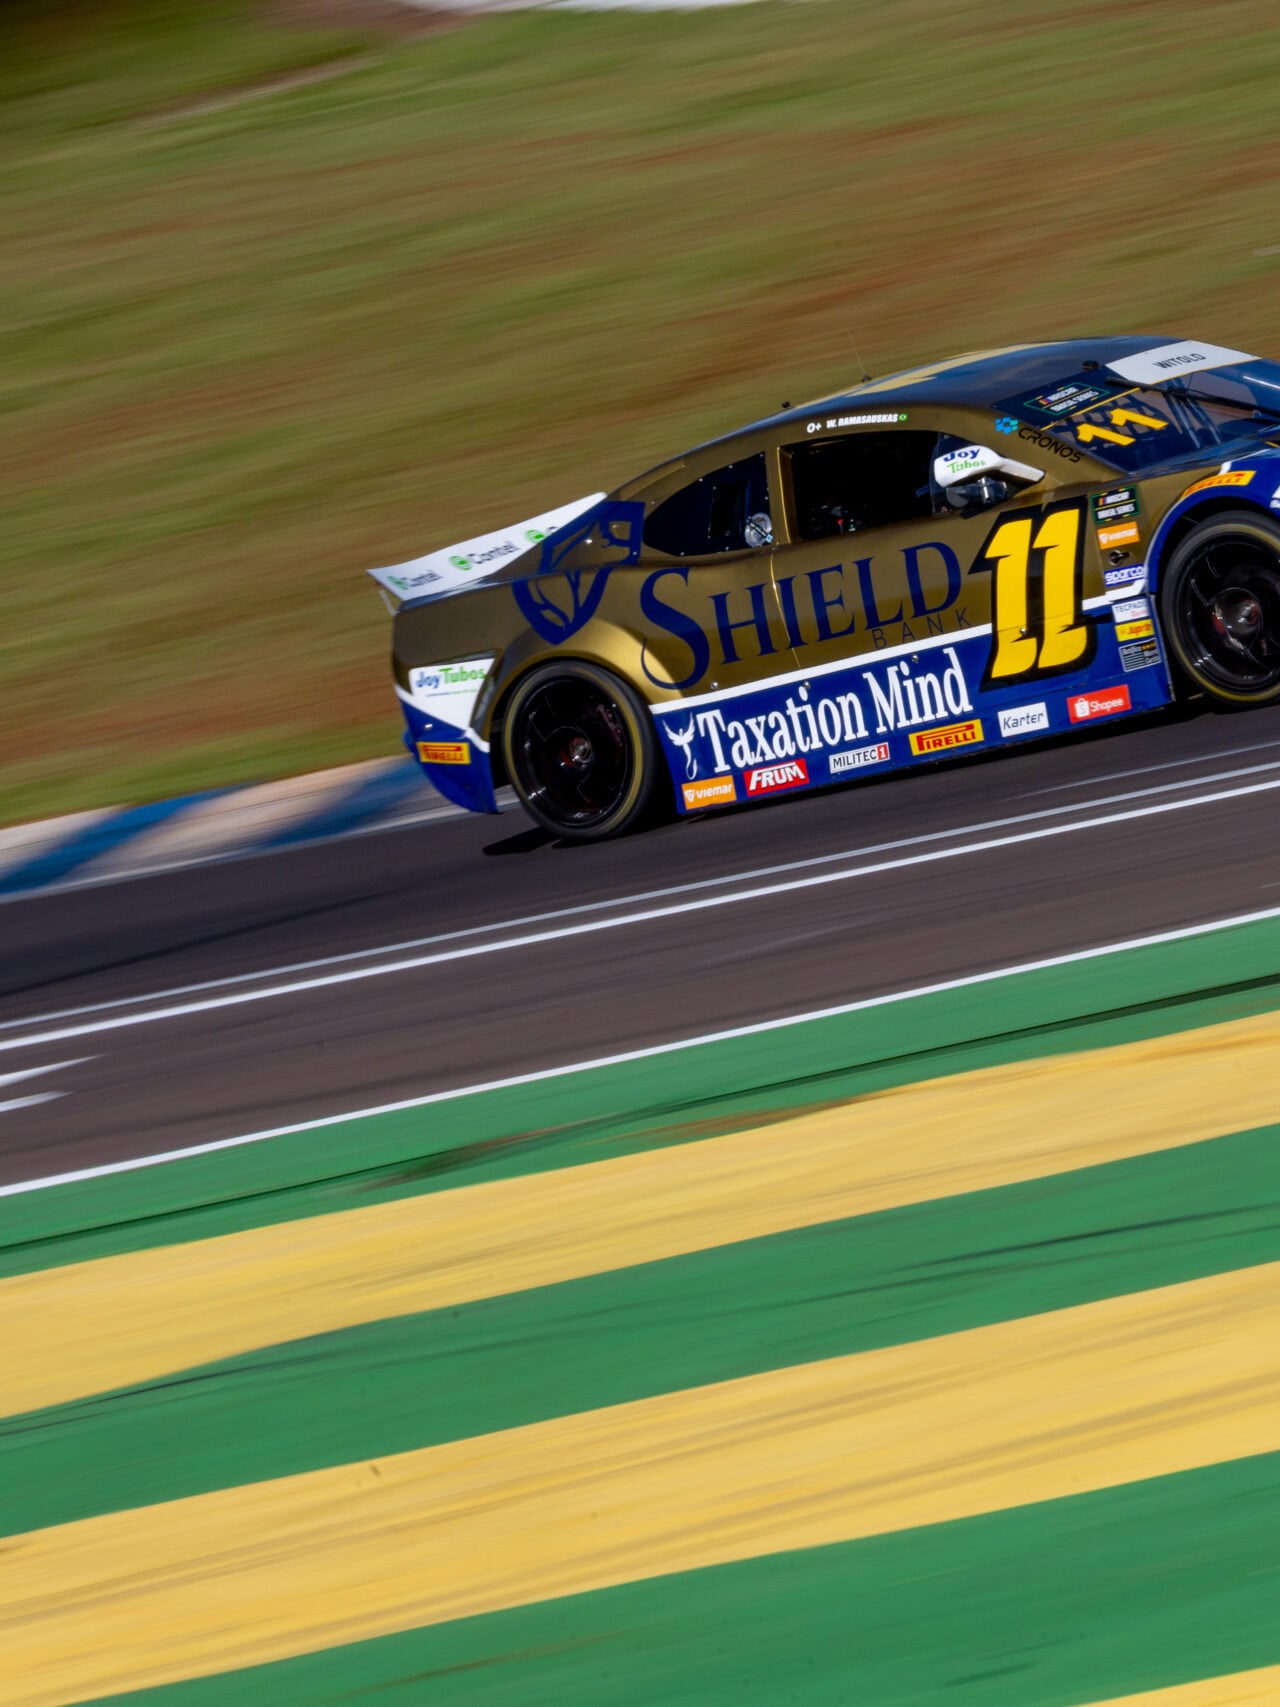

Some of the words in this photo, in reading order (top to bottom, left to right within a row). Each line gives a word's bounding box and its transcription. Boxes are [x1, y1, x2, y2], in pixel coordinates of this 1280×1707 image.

[1153, 353, 1206, 369] WITOLD
[827, 419, 838, 429] W.
[838, 413, 899, 427] RAMASAUSKAS
[943, 447, 981, 462] Joy
[1018, 427, 1085, 463] CRONOS
[946, 459, 986, 473] Tubos
[1105, 565, 1145, 582] sparco
[984, 508, 1087, 679] 11
[639, 541, 963, 691] SHIELD
[872, 607, 974, 649] BANK
[696, 686, 869, 773] Taxation
[863, 647, 974, 734] Mind
[1090, 698, 1123, 713] Shopee
[1003, 714, 1044, 730] Karter
[916, 724, 976, 752] PIRELLI
[749, 763, 805, 791] FRUM
